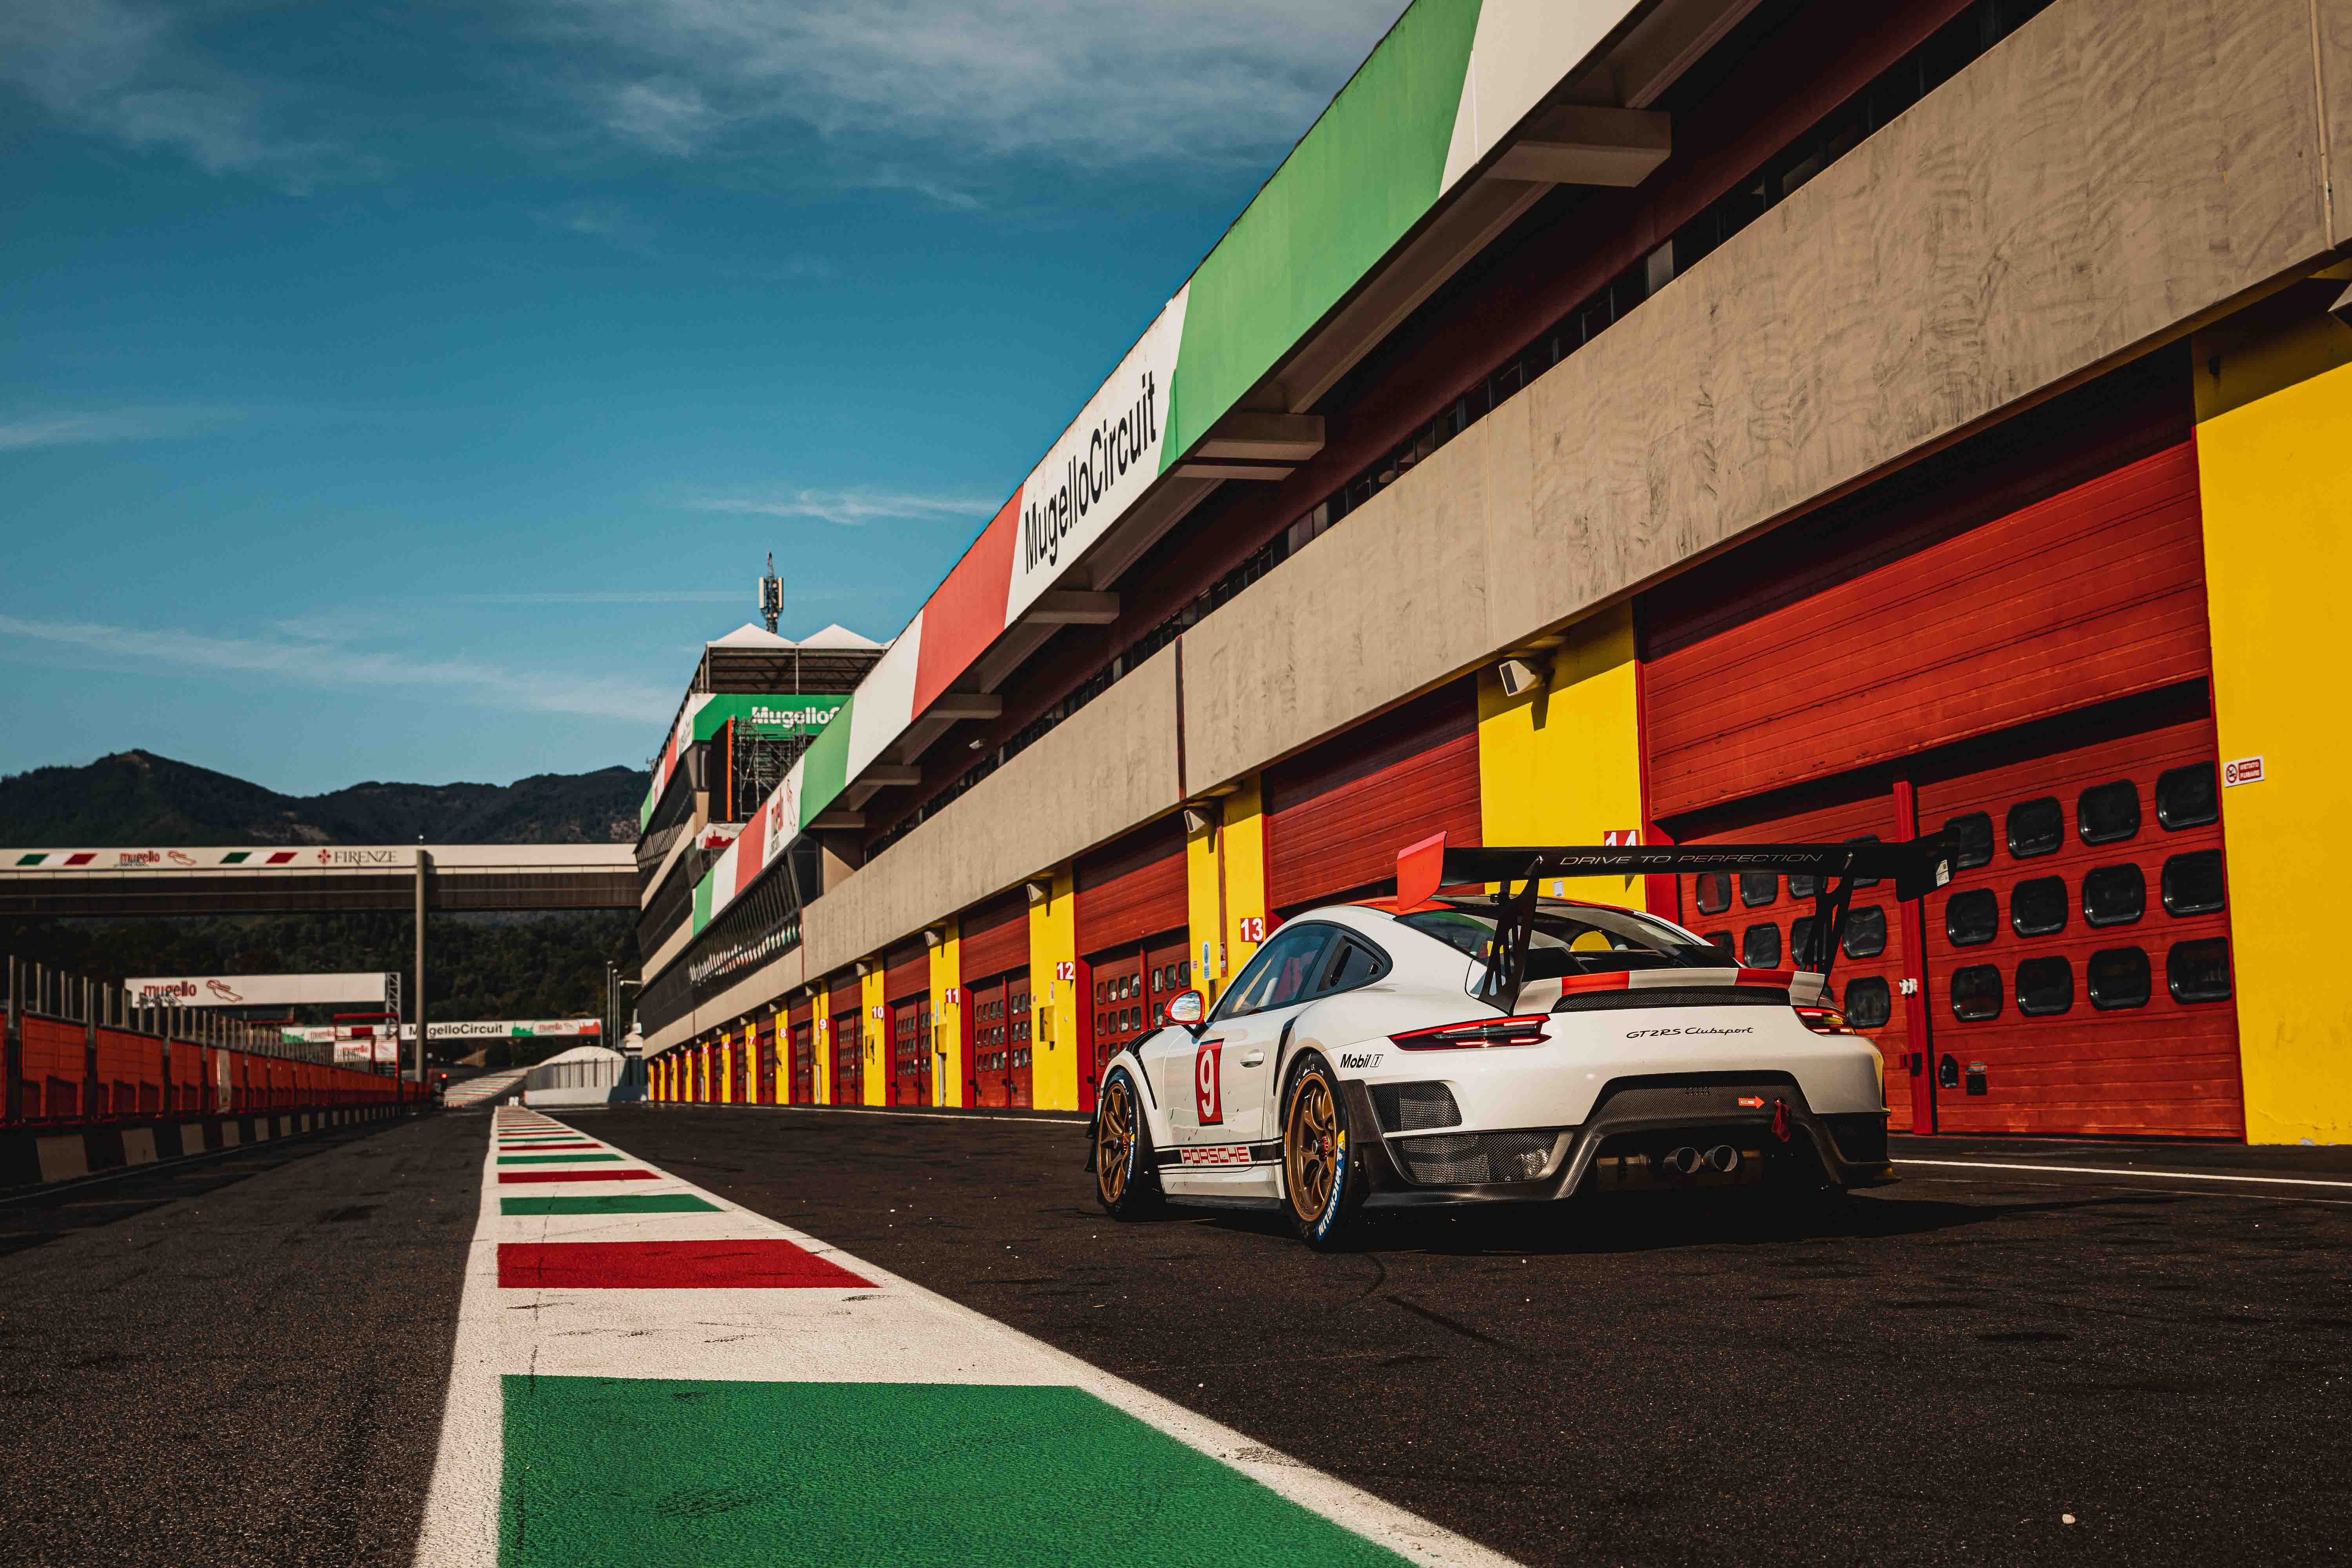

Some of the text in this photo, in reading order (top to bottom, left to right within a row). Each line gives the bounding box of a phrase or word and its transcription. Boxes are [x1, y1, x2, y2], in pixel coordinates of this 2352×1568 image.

[1025, 370, 1156, 574] MugelloCircuit
[334, 850, 398, 866] FIRENZE
[1560, 856, 1632, 865] DRIVE
[1678, 854, 1823, 863] PERFECTION
[1241, 918, 1263, 941] 13
[1057, 962, 1074, 979] 12
[946, 989, 959, 1003] 11
[872, 1006, 883, 1018] 10
[409, 1023, 503, 1038] MgelloCircuit
[819, 1019, 827, 1029] 9
[780, 1028, 787, 1037] 8
[1626, 1029, 1681, 1038] GT2RS
[1340, 1054, 1372, 1068] Mobil
[1200, 1049, 1214, 1117] 9
[1181, 1146, 1250, 1164] PORSCHE
[1319, 1165, 1341, 1236] MICHELIN
